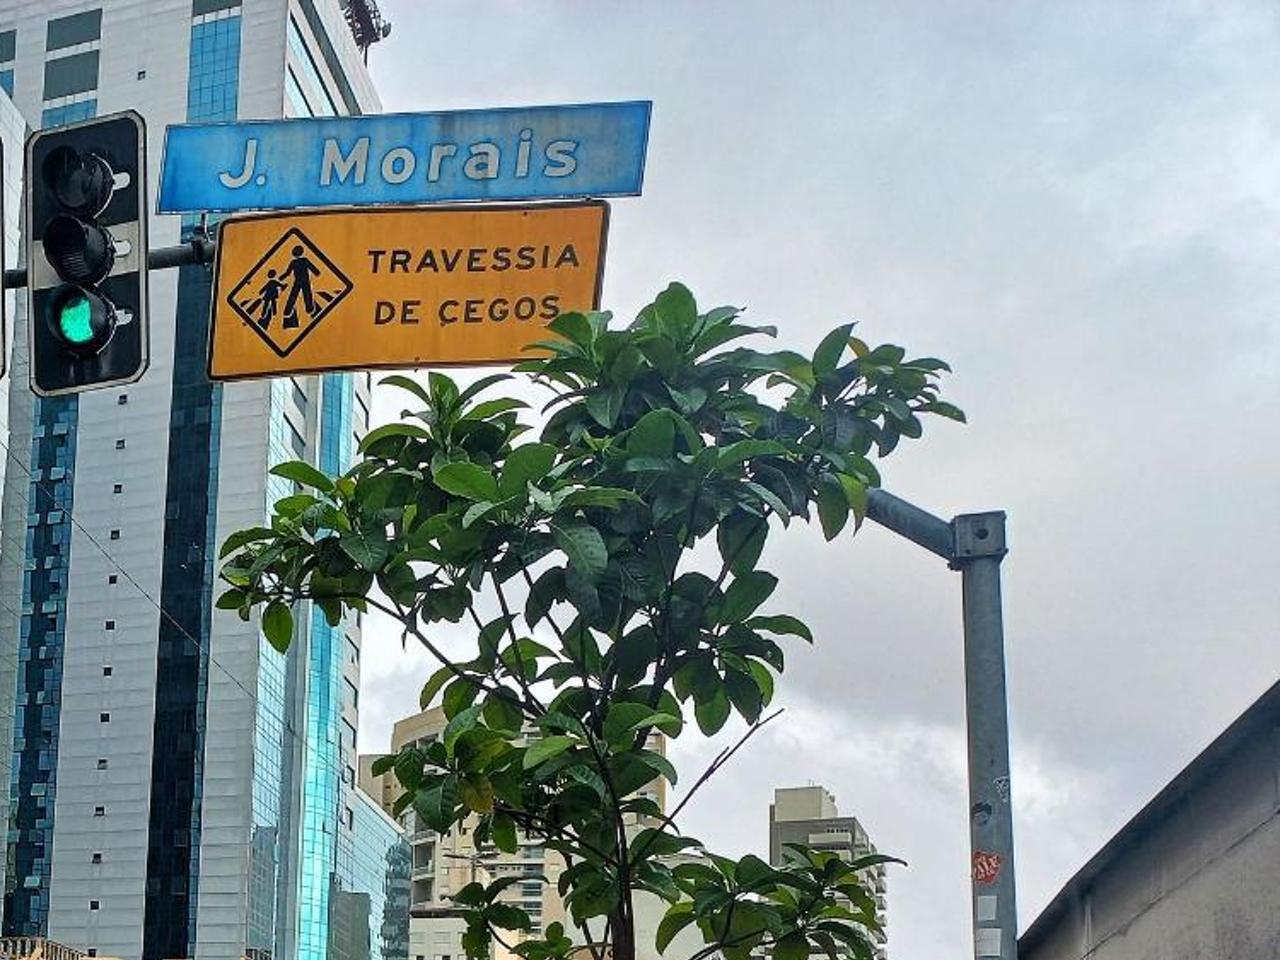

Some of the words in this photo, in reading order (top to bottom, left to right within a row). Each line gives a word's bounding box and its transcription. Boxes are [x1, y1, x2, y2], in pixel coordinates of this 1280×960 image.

[219, 139, 267, 190] J.
[320, 128, 580, 188] Morais
[367, 243, 581, 275] TRAVESSIA
[373, 300, 421, 326] DE
